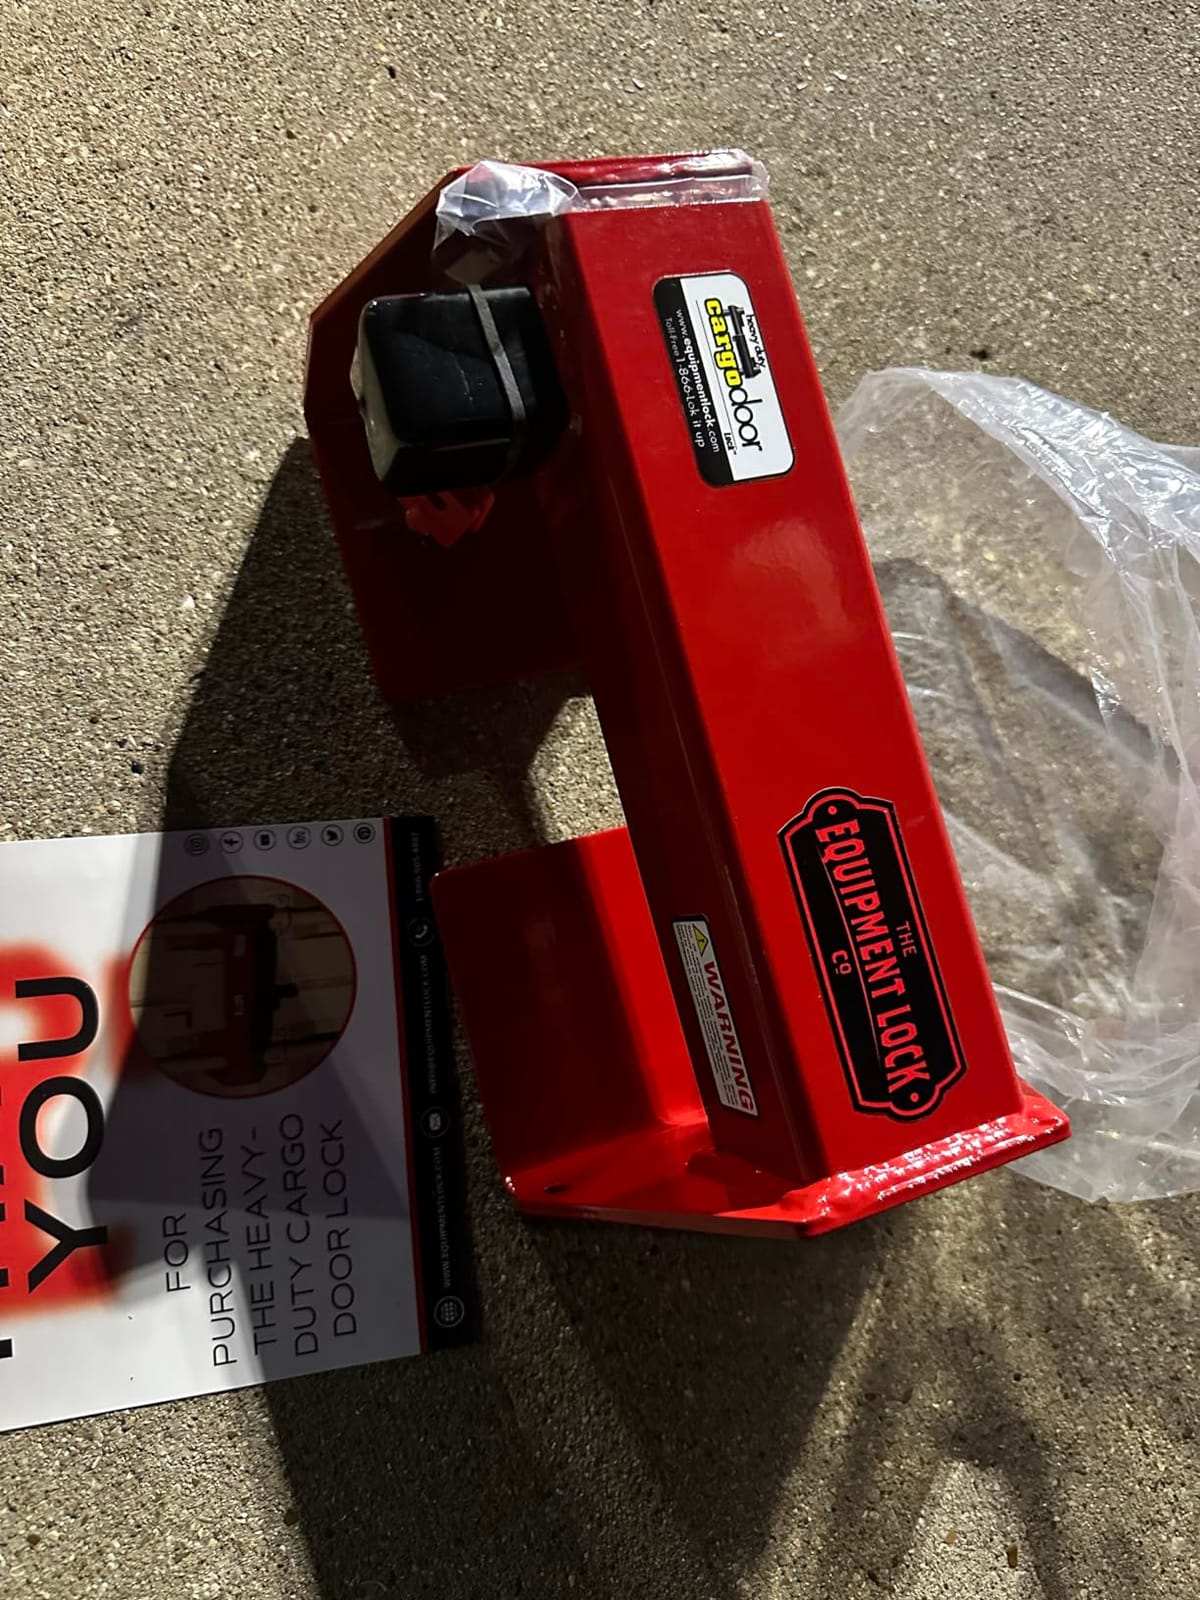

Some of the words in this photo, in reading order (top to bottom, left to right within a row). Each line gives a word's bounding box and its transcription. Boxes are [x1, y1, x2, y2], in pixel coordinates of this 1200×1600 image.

[664, 317, 679, 357] Toll-Free
[676, 309, 720, 453] www.equipmentlock.com
[676, 356, 697, 416] 1-866-Lok
[745, 314, 758, 345] heavy
[754, 343, 766, 369] duty
[692, 419, 700, 430] it
[695, 432, 705, 448] up
[815, 818, 906, 1000] EQUIPMENT
[876, 1004, 930, 1093] LOCK
[896, 921, 917, 958] THE
[703, 960, 754, 1110] WARNING
[15, 976, 108, 1293] YOU
[280, 1113, 311, 1244] CARGO
[320, 1120, 350, 1220] LOCK
[200, 1127, 237, 1366] PURCHASING
[241, 1127, 273, 1273] HEAVY-
[432, 1146, 451, 1289] WWW.EQUIPMENTLOCK.COM
[163, 1212, 191, 1293] FOR
[327, 1227, 357, 1337] DOOR
[250, 1280, 277, 1355] THE
[289, 1257, 318, 1357] DUTY
